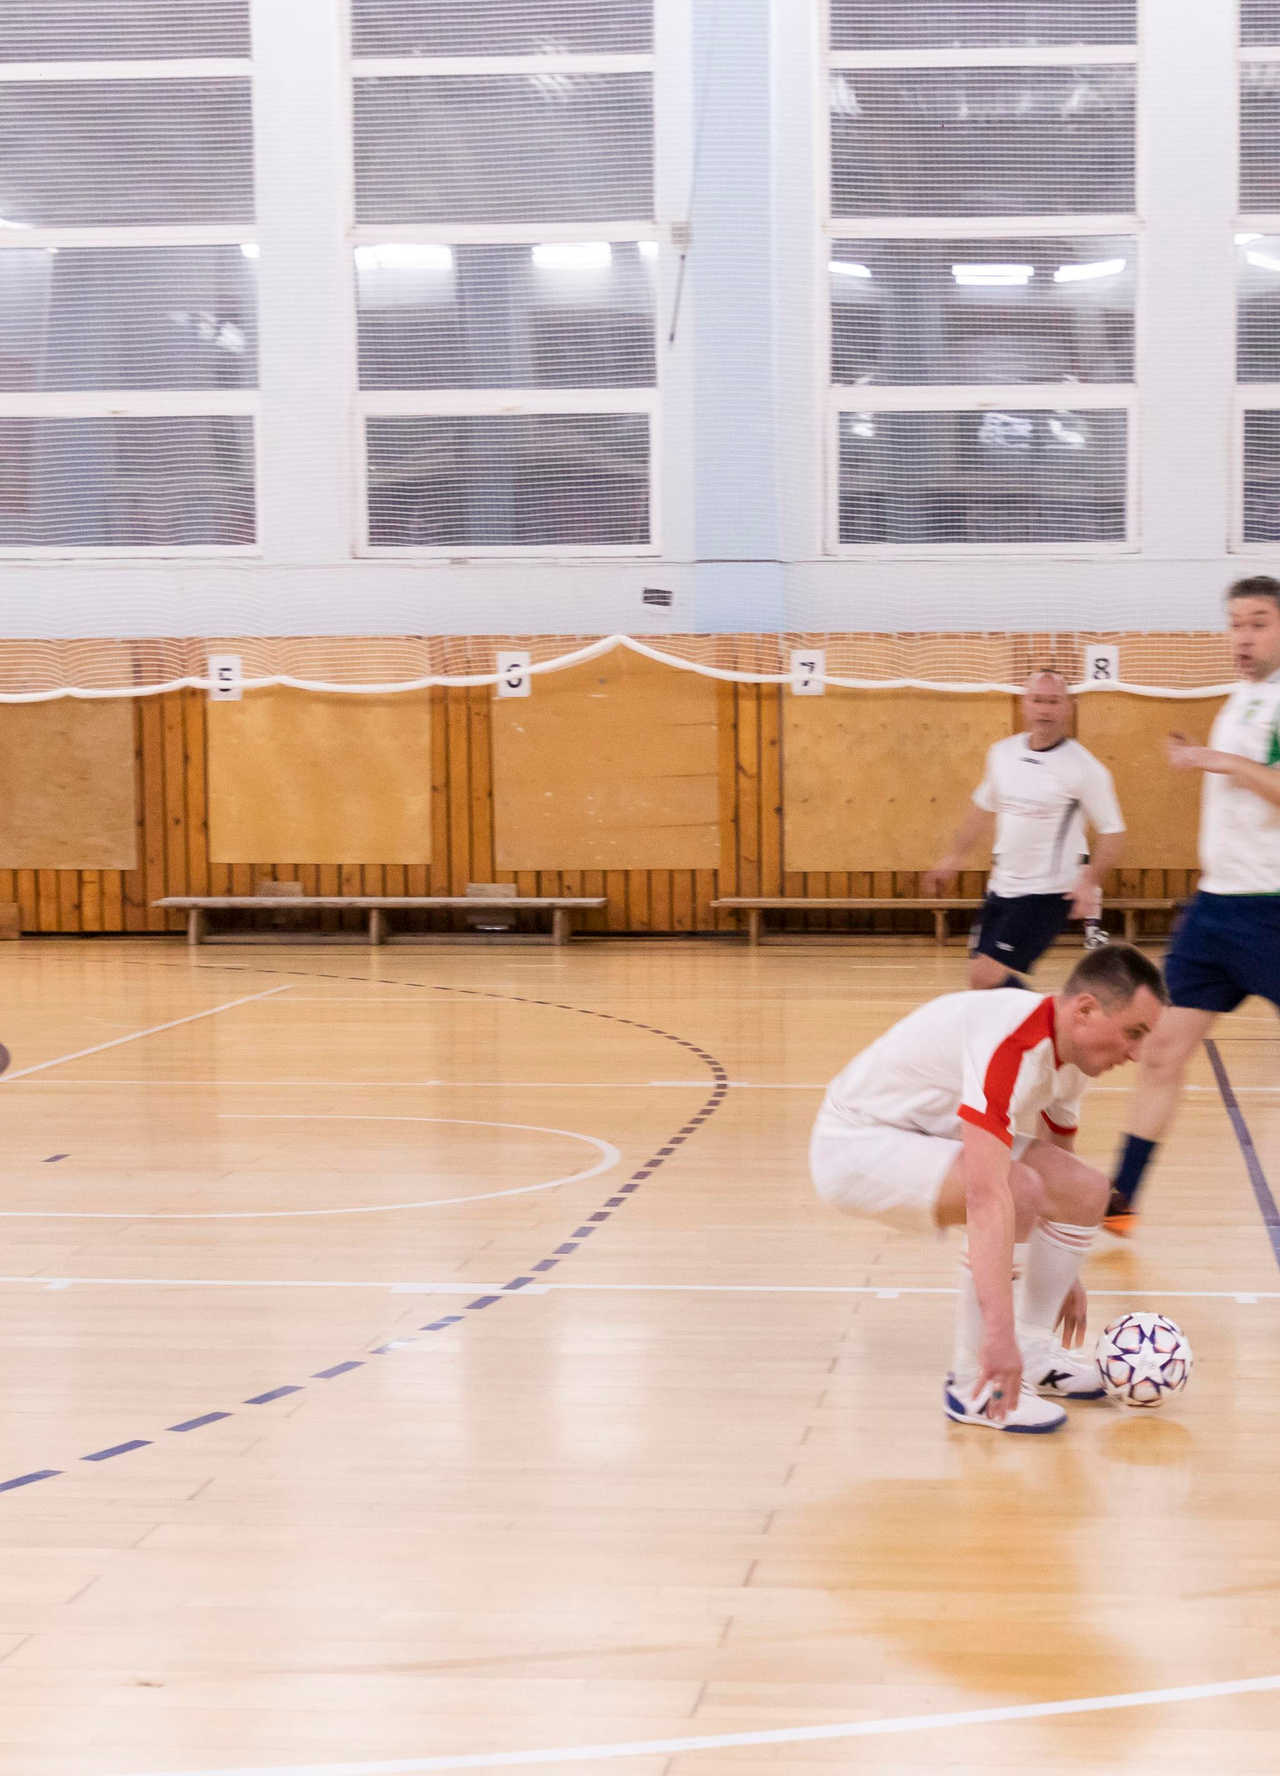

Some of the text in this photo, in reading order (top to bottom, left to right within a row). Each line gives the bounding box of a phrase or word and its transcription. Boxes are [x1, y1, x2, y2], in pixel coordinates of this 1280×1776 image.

[218, 667, 232, 692] 5
[799, 661, 816, 687] 7
[1093, 658, 1110, 680] 8
